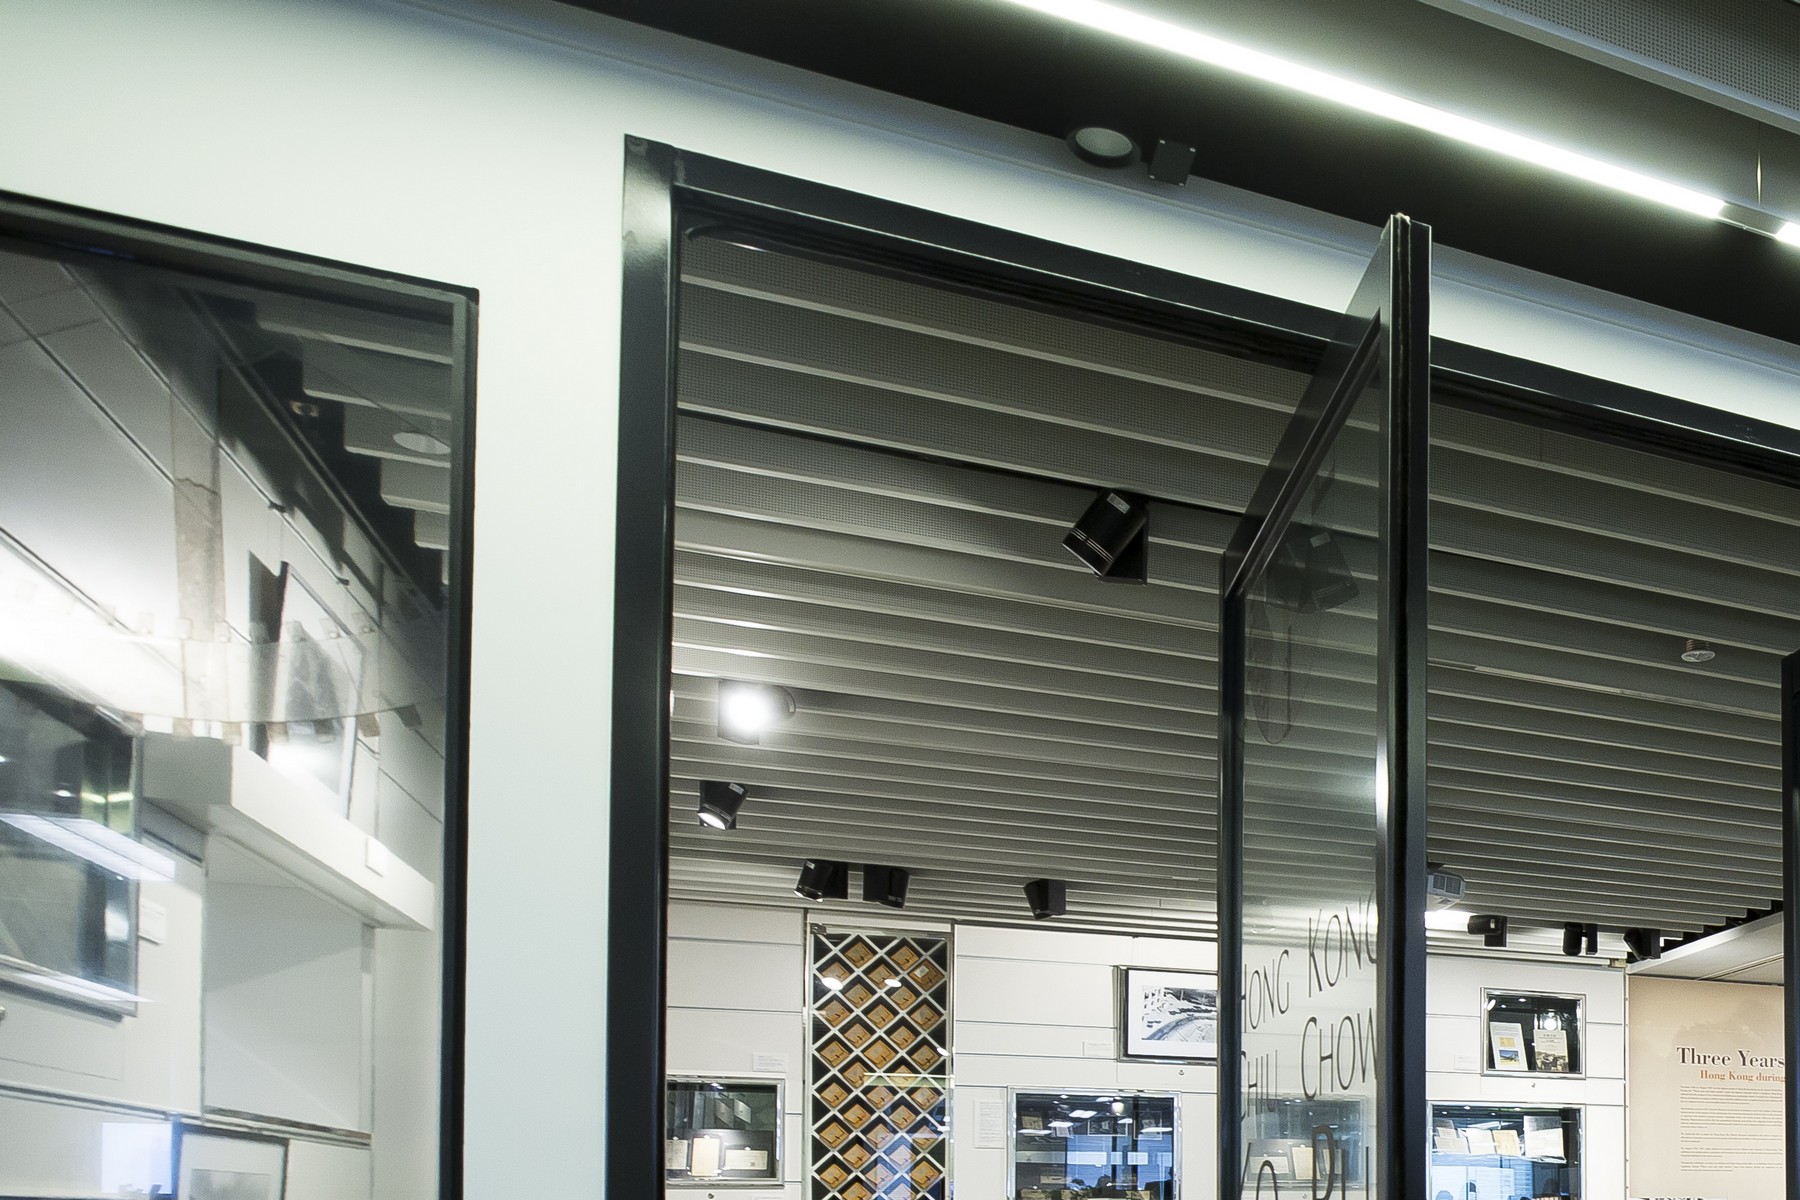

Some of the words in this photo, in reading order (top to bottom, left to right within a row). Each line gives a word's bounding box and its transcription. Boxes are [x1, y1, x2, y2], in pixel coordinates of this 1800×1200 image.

[1676, 1047, 1732, 1066] Three
[1737, 1050, 1785, 1068] Years
[1700, 1069, 1726, 1081] Hong
[1728, 1071, 1754, 1082] Kong
